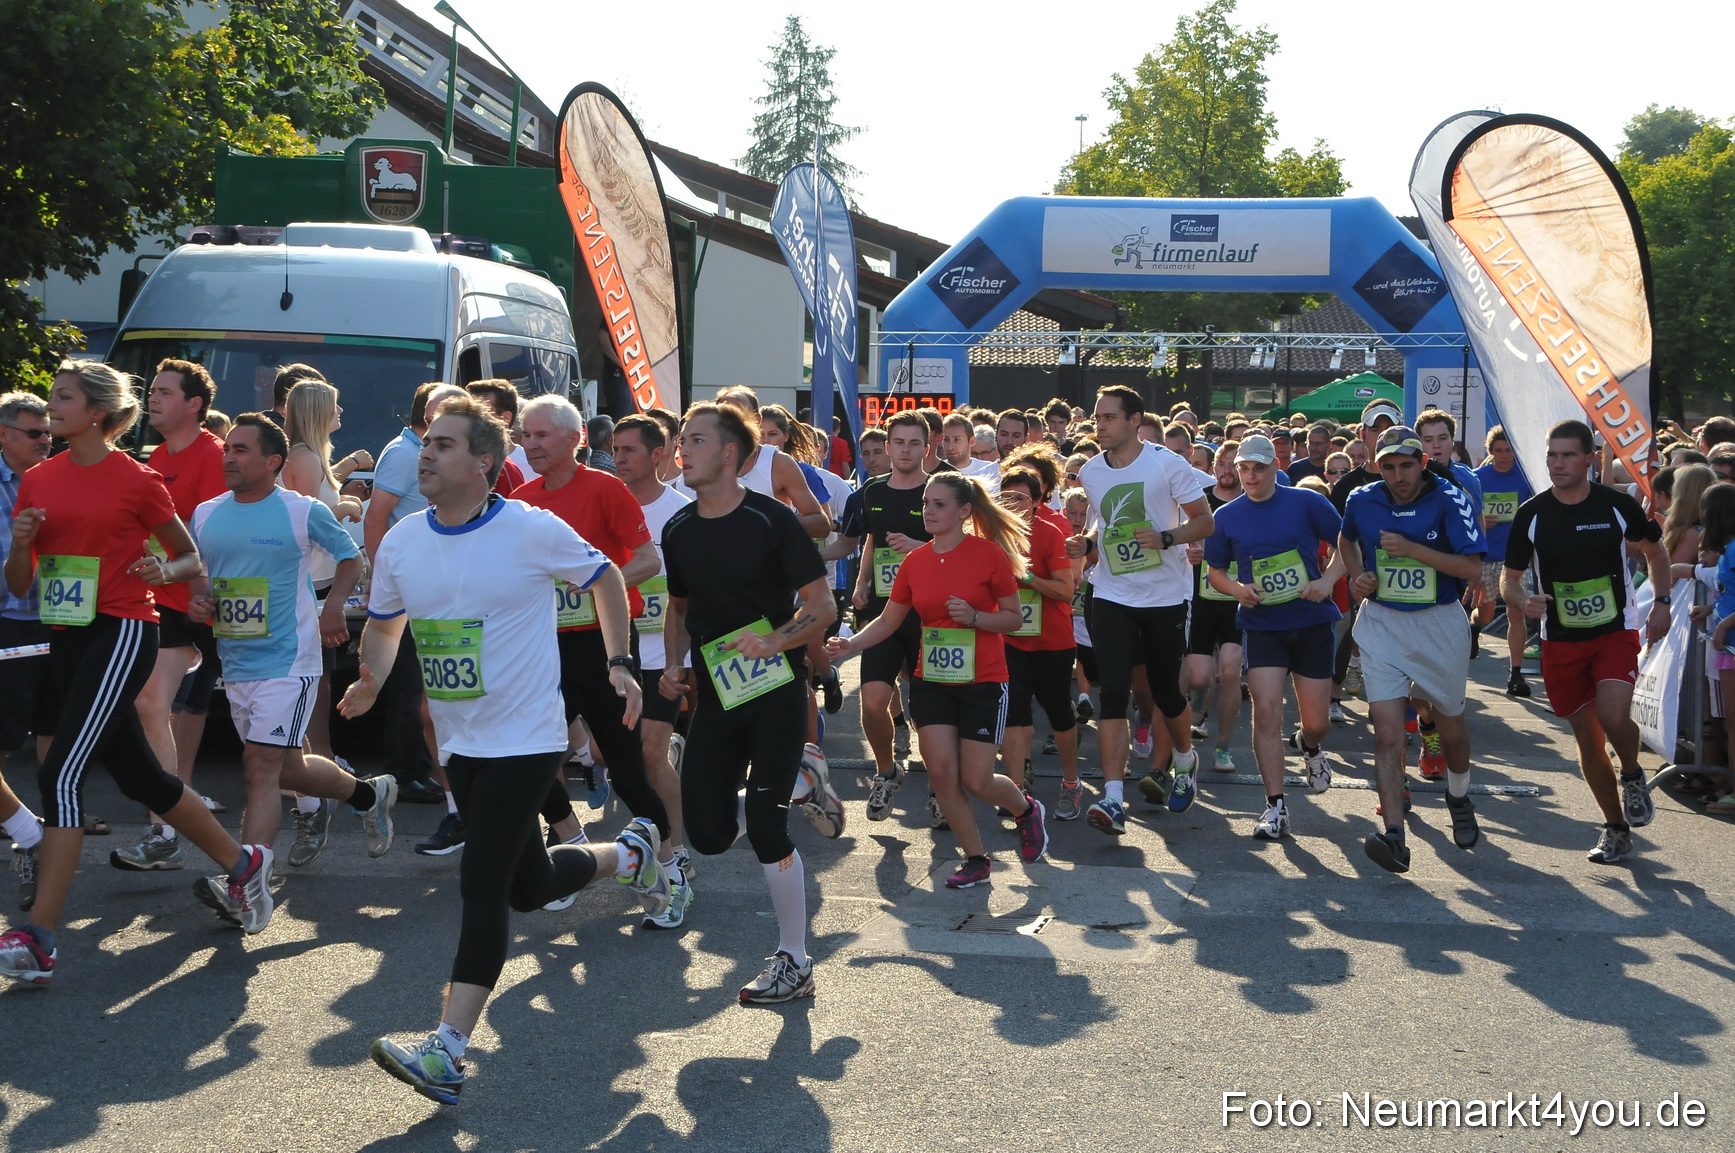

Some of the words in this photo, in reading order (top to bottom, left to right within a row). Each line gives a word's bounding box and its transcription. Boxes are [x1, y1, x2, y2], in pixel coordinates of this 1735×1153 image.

[379, 204, 408, 217] 1628
[1179, 222, 1216, 233] Fischer
[1152, 243, 1260, 263] firmenlauf
[1151, 262, 1196, 271] neumarkt
[949, 272, 1007, 289] Fischer
[1372, 282, 1388, 290] und
[1390, 279, 1405, 287] das
[1392, 510, 1416, 518] hummel
[1488, 503, 1512, 515] 702
[1581, 523, 1611, 531] PFLEIDERER
[1116, 540, 1145, 562] 92
[1261, 567, 1300, 594] 693
[1384, 568, 1426, 590] 708
[44, 579, 84, 608] 494
[215, 599, 265, 624] 1384
[1564, 595, 1606, 618] 969
[927, 646, 965, 669] 498
[422, 657, 478, 690] 5083
[714, 653, 784, 691] 1124
